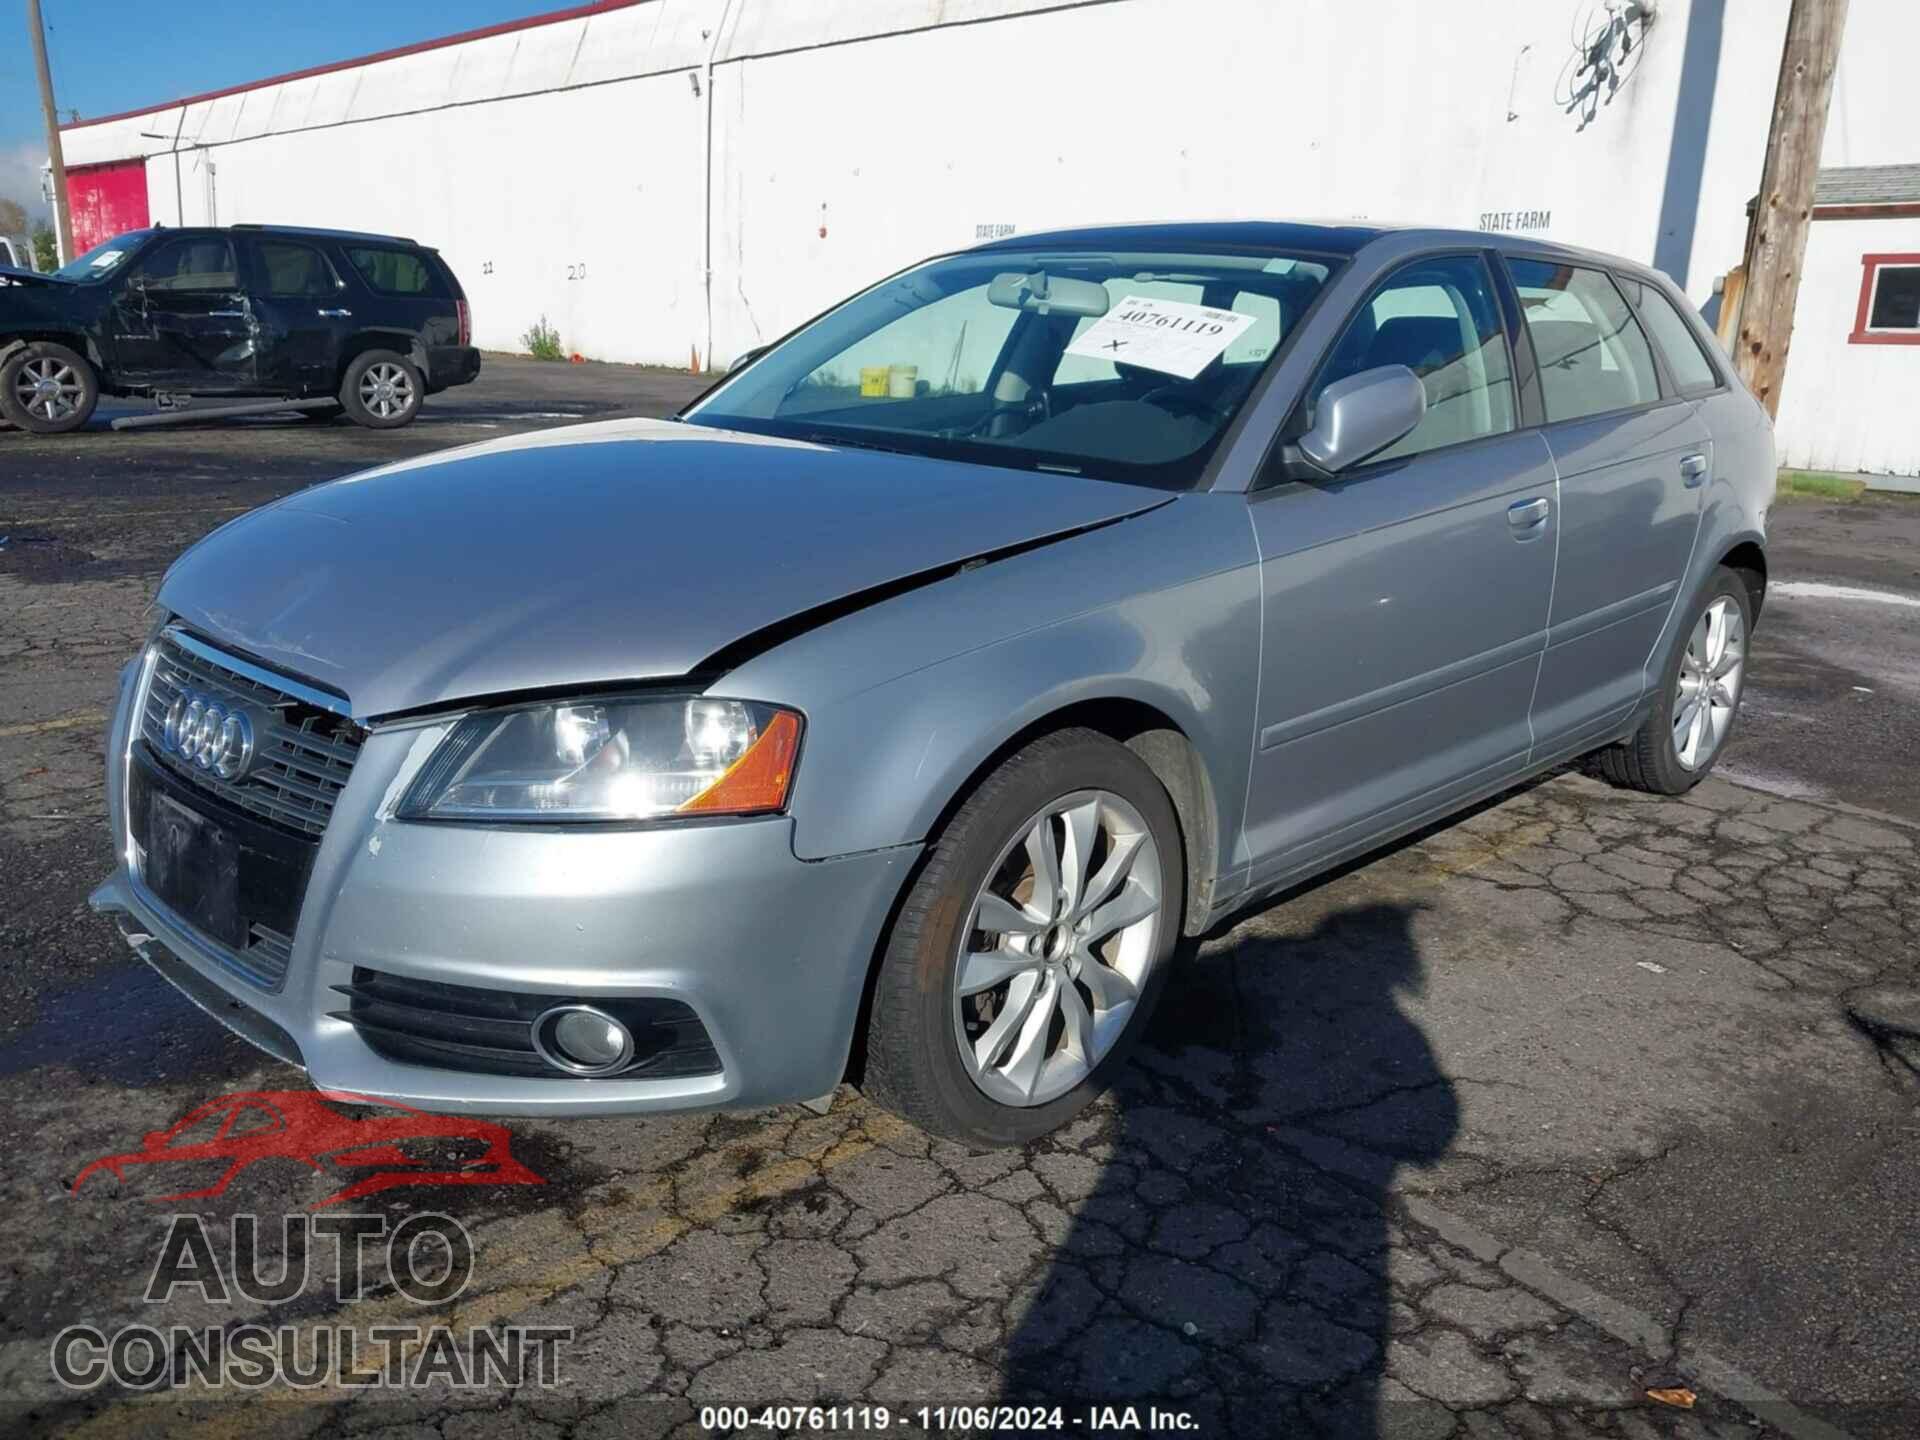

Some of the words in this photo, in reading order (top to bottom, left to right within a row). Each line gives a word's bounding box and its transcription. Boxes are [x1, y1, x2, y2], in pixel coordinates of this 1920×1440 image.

[1479, 212, 1512, 231] STATE
[1515, 210, 1551, 230] FARM
[567, 262, 586, 281] 20
[1119, 310, 1224, 336] 40761119
